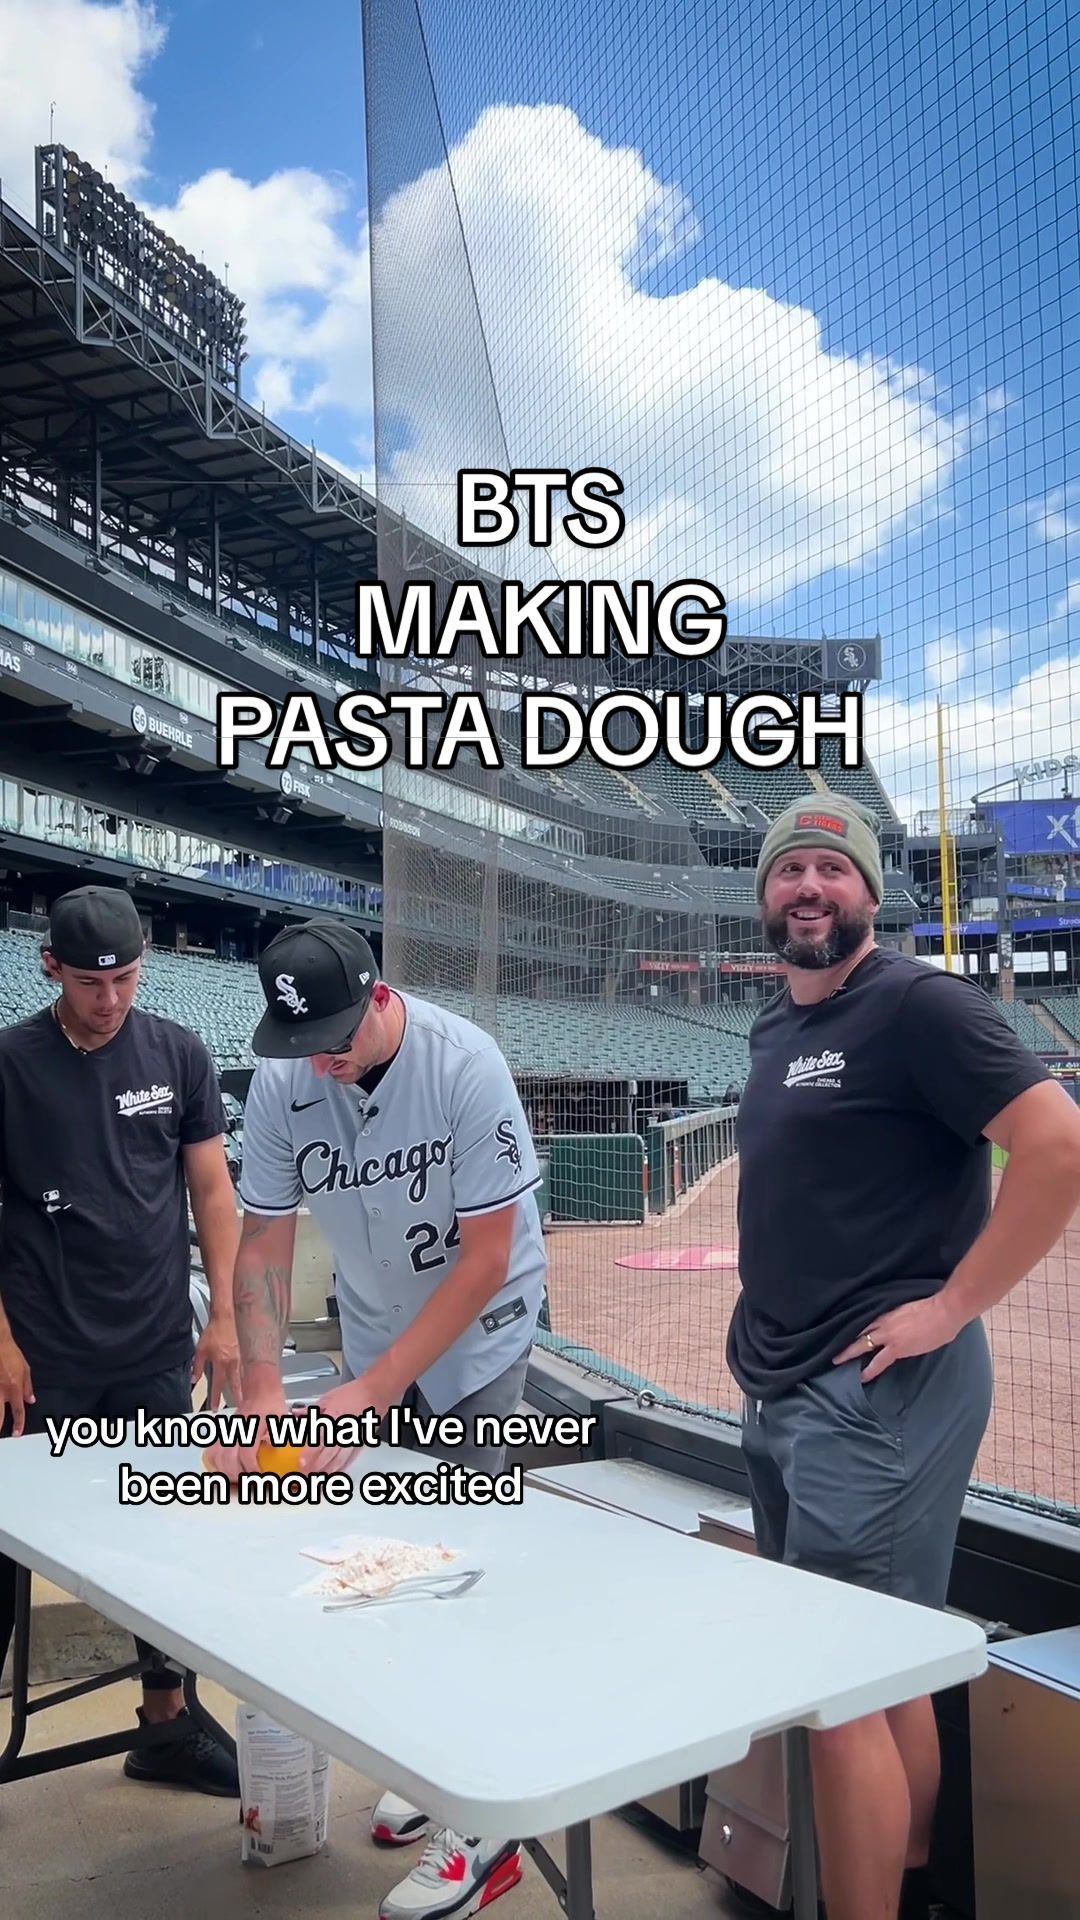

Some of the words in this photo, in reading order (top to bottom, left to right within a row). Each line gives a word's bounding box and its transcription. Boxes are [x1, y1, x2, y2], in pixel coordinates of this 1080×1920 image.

[148, 716, 193, 749] BUEHRLE
[1013, 754, 1080, 785] KIDS
[293, 779, 311, 798] FISK
[275, 973, 309, 1015] Sox
[785, 1056, 817, 1079] White
[816, 1049, 844, 1069] Sox
[115, 1089, 151, 1110] White
[150, 1084, 170, 1100] Sox
[295, 1134, 454, 1204] Chicago
